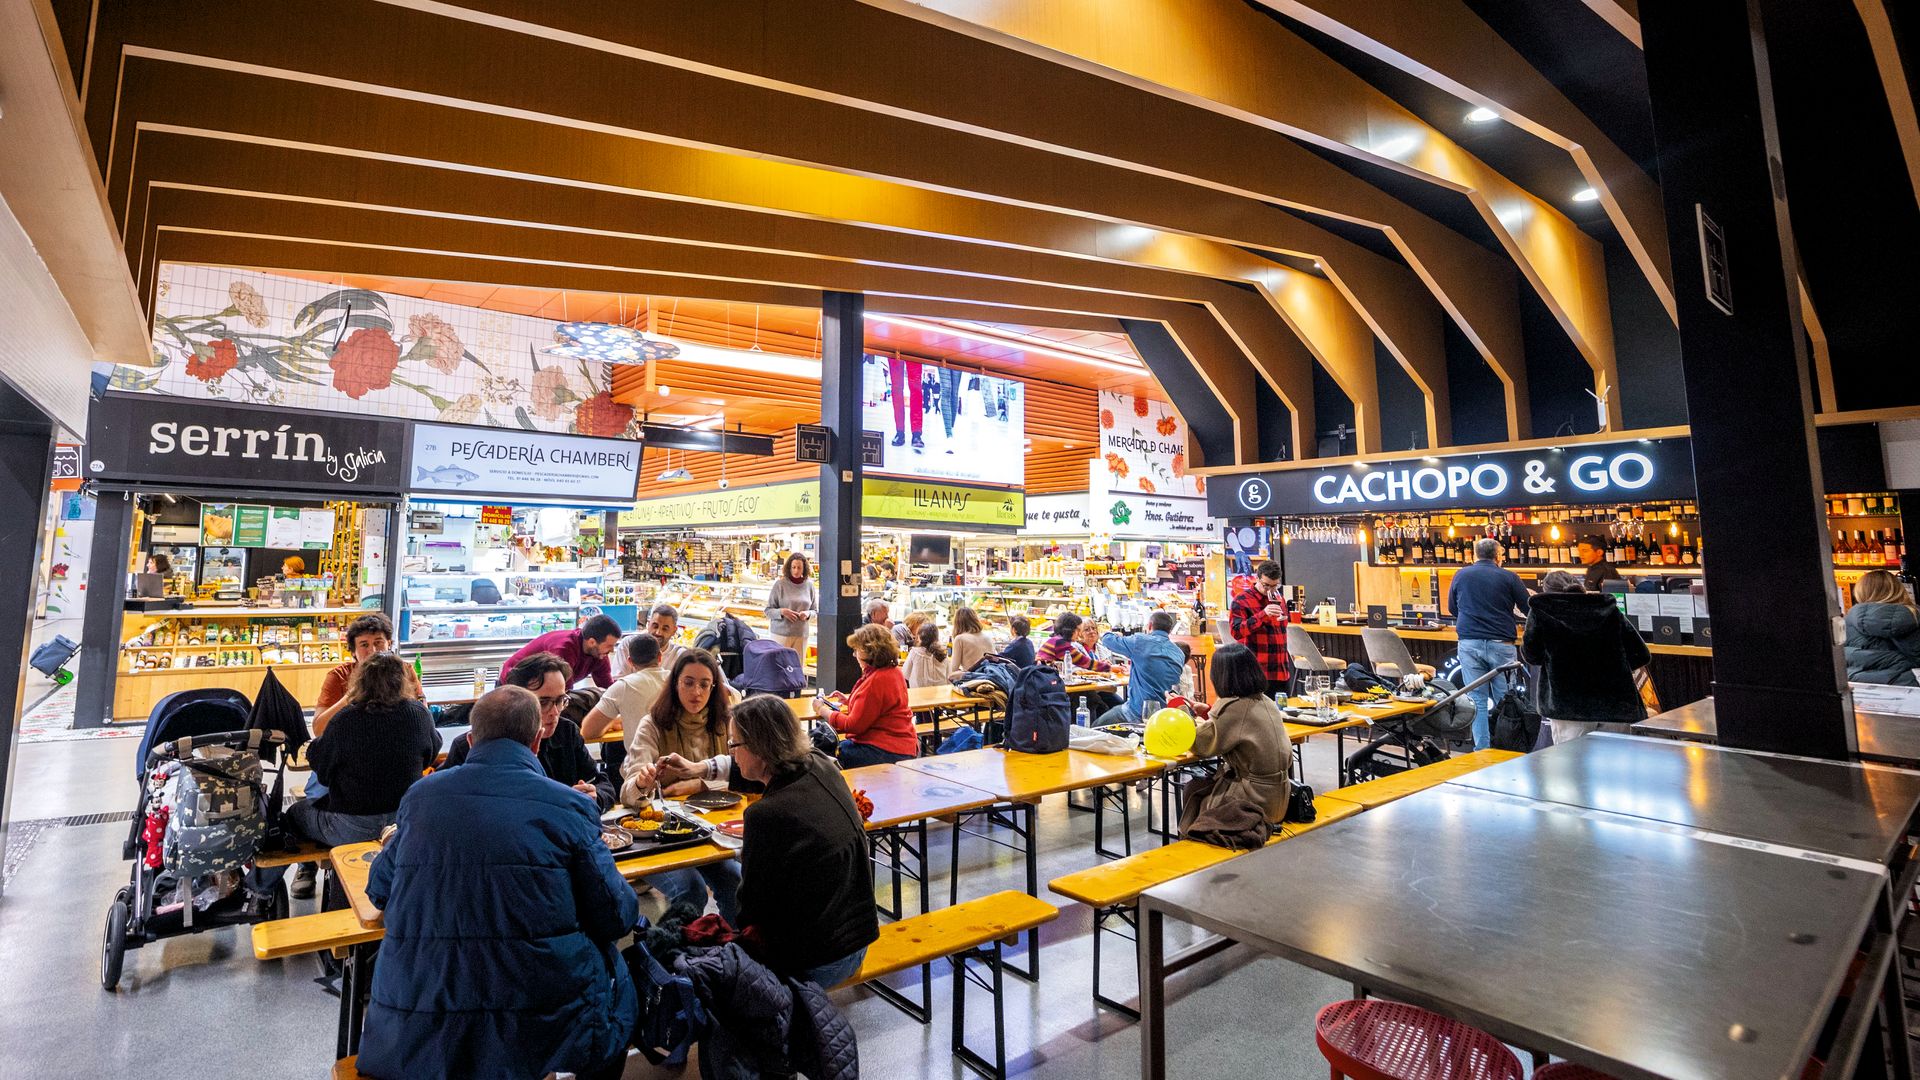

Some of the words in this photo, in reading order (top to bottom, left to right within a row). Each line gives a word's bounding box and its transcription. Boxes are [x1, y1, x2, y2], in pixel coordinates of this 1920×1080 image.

[149, 422, 326, 463] serrín
[1108, 434, 1148, 453] MERCADO
[327, 447, 339, 477] by
[339, 447, 386, 482] galicia
[451, 440, 545, 466] PESCADERÍA
[550, 449, 633, 472] CHAMBERÍ
[1313, 461, 1508, 504] CACHOPO
[1523, 460, 1555, 494] &
[1569, 452, 1654, 491] GO
[702, 498, 733, 519] FRUTOS
[732, 494, 760, 517] SECOS
[914, 488, 971, 511] ILLANAS
[1041, 510, 1051, 520] te
[1053, 508, 1080, 524] gusta
[1165, 511, 1194, 523] Gutiérrez
